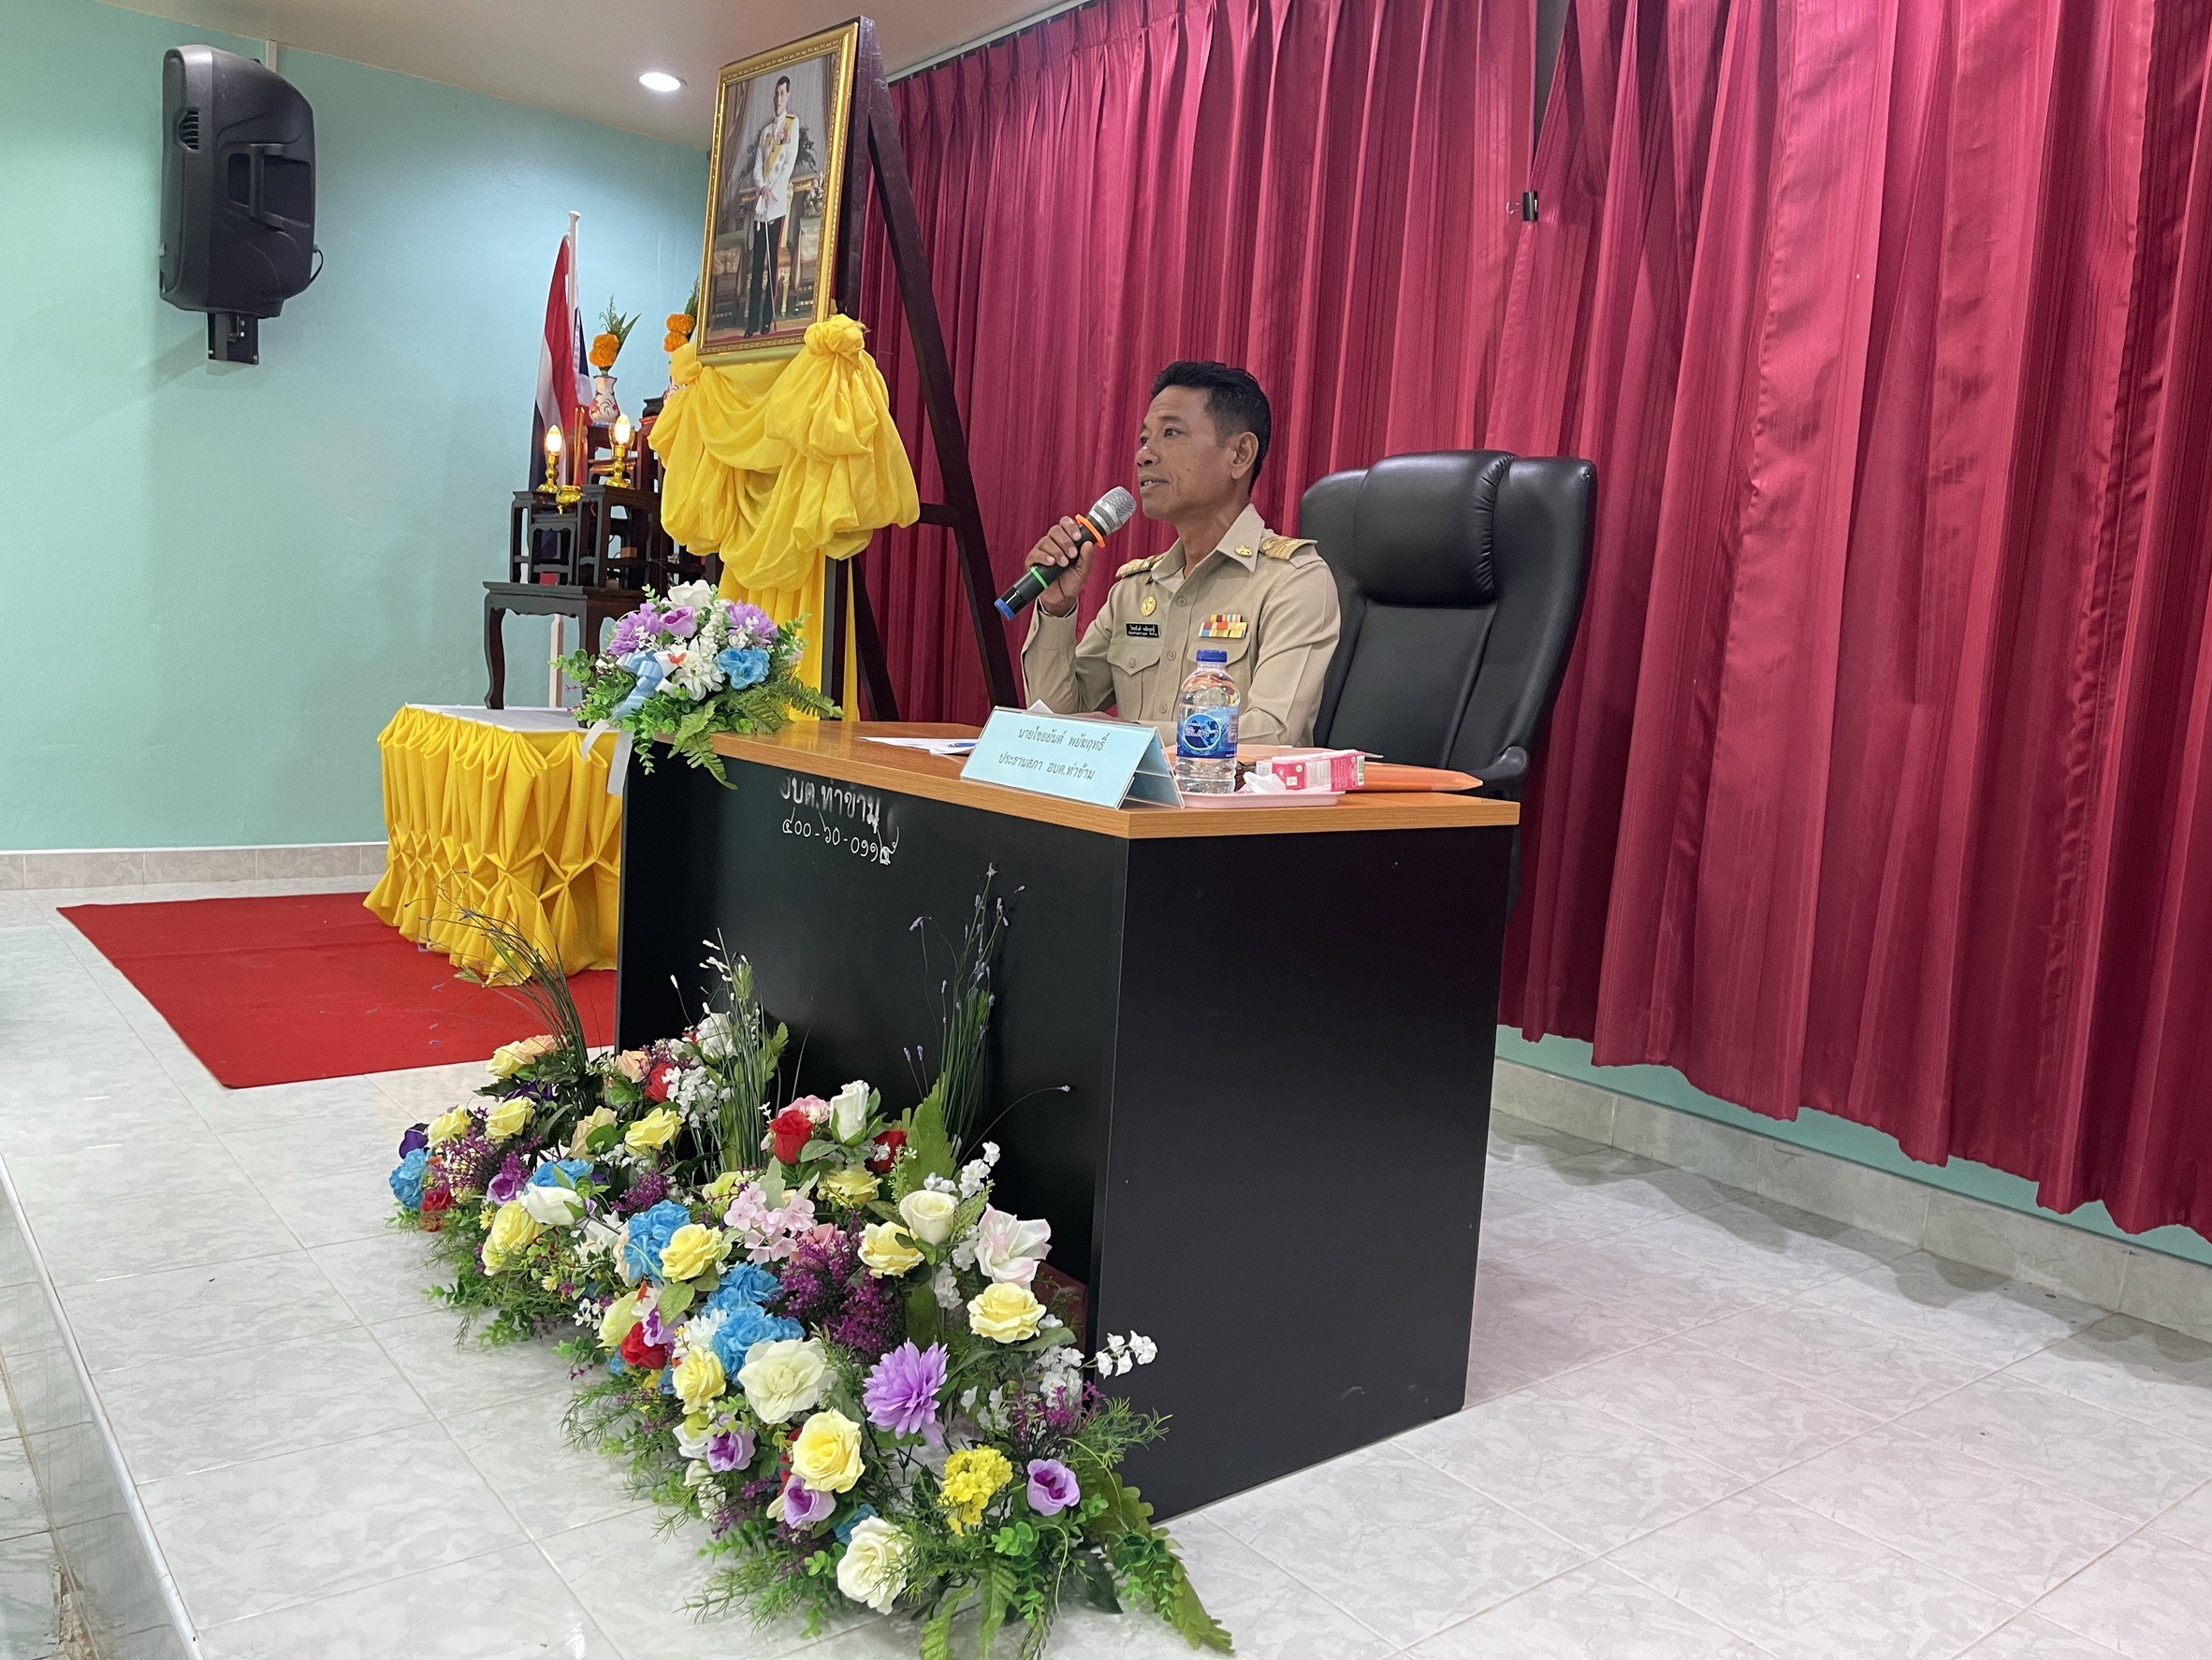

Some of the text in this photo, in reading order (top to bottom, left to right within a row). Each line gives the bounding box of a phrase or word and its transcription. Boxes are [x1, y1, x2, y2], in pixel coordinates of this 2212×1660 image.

[998, 751, 1095, 780] ประธานสภา อบต.ท่าข้าม
